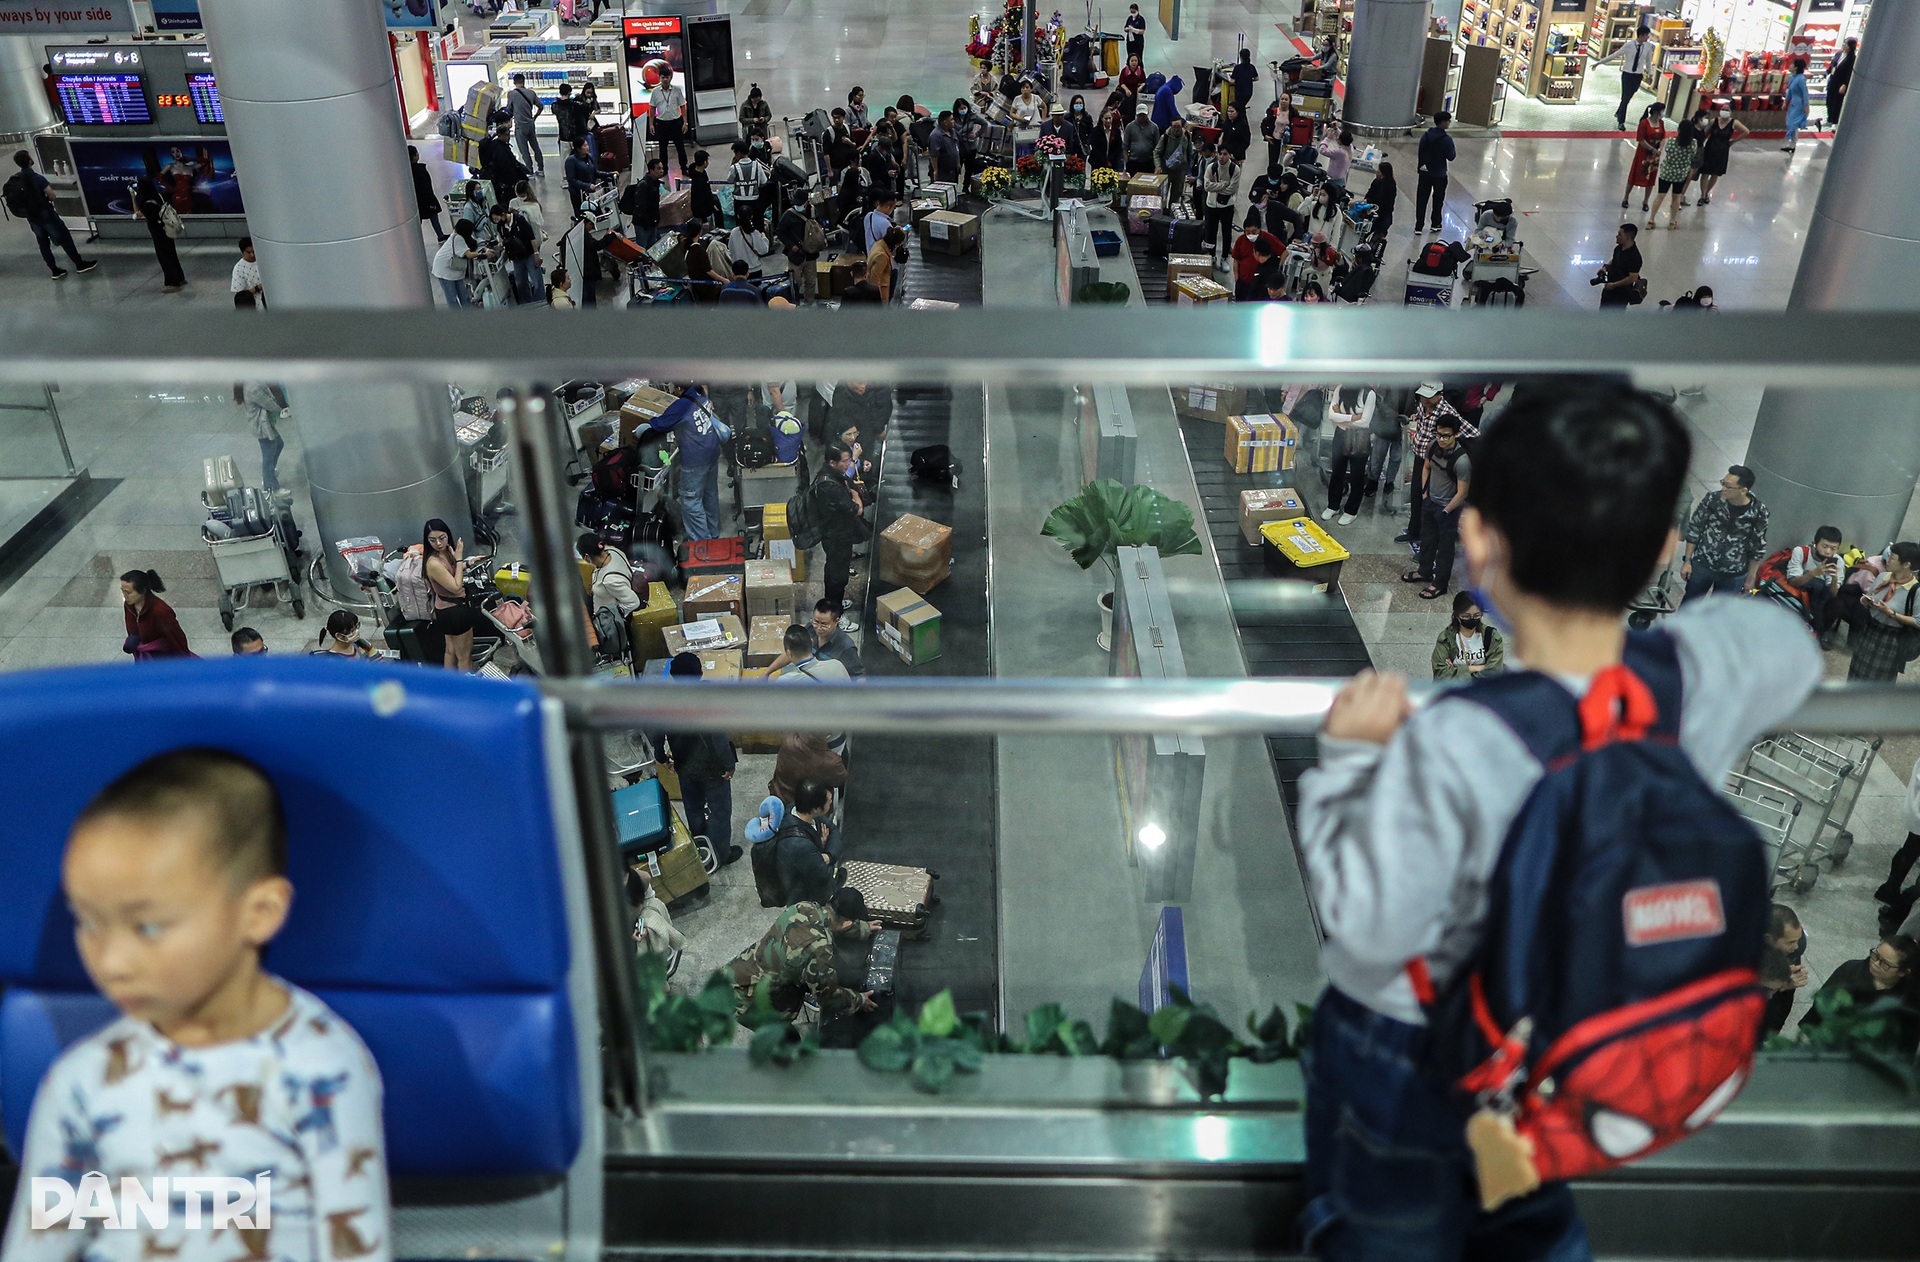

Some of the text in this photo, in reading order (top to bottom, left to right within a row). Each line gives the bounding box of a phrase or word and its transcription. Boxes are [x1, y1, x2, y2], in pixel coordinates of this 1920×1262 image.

[34, 7, 50, 24] by
[54, 11, 82, 24] your
[86, 7, 112, 21] side
